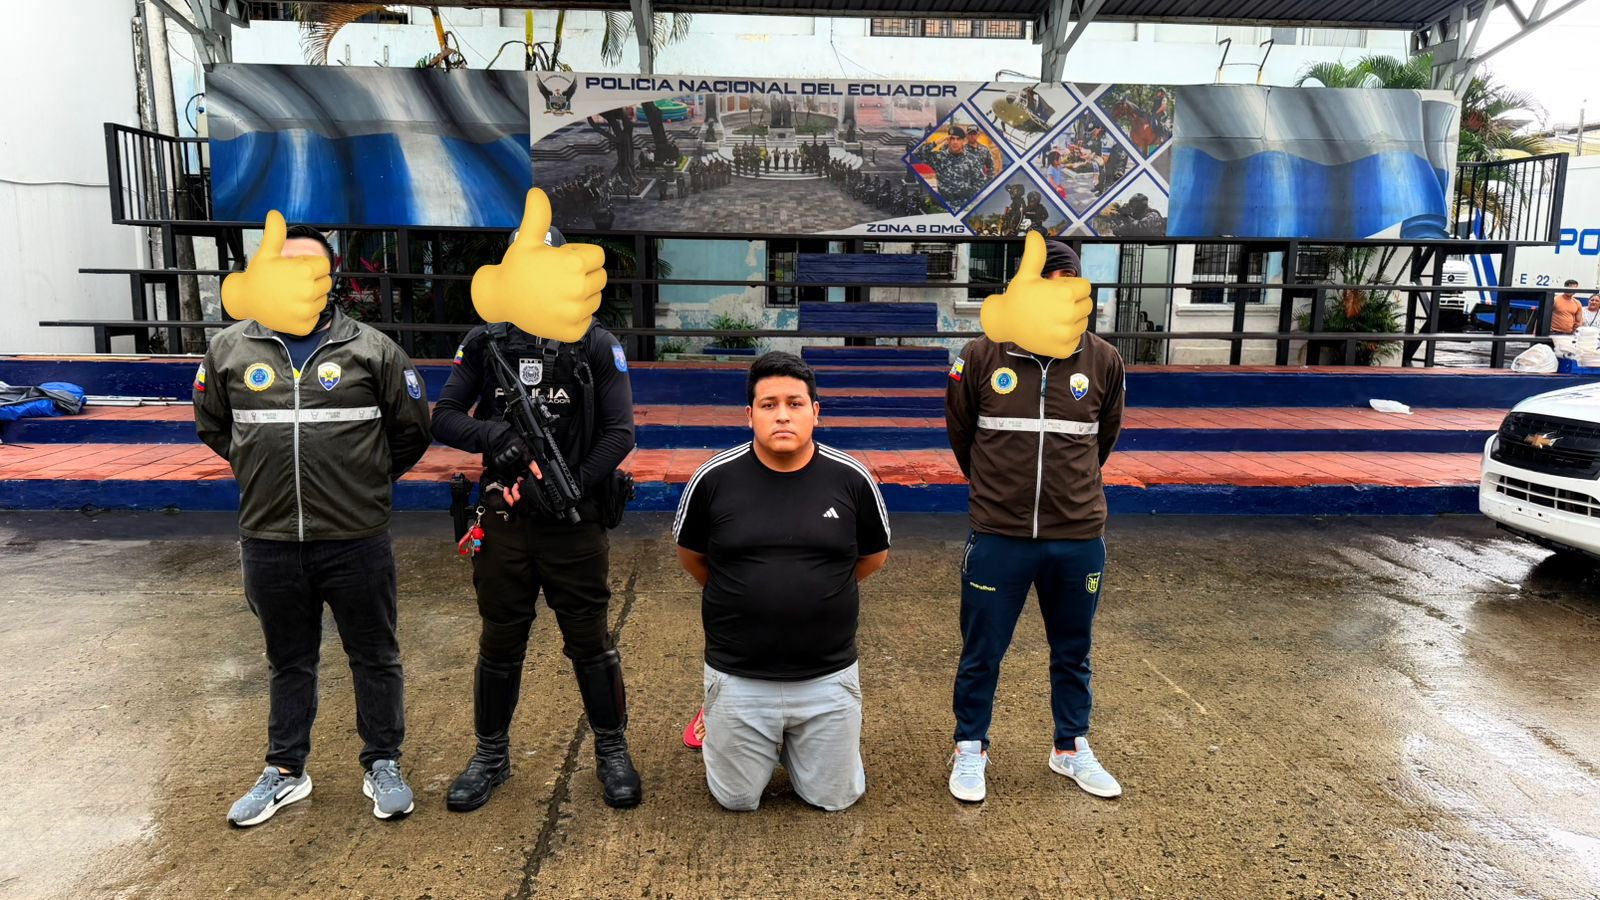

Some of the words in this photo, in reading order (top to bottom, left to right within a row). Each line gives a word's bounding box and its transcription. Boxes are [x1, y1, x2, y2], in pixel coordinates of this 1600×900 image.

[585, 76, 674, 92] POLICIA
[679, 79, 798, 95] NACIONAL
[801, 82, 843, 96] DEL
[848, 83, 957, 98] ECUADOR
[866, 223, 913, 233] ZONA
[916, 224, 927, 233] 8
[930, 224, 965, 234] DMG
[1520, 273, 1528, 285] E
[1536, 274, 1550, 287] 22
[494, 387, 571, 399] PIIA
